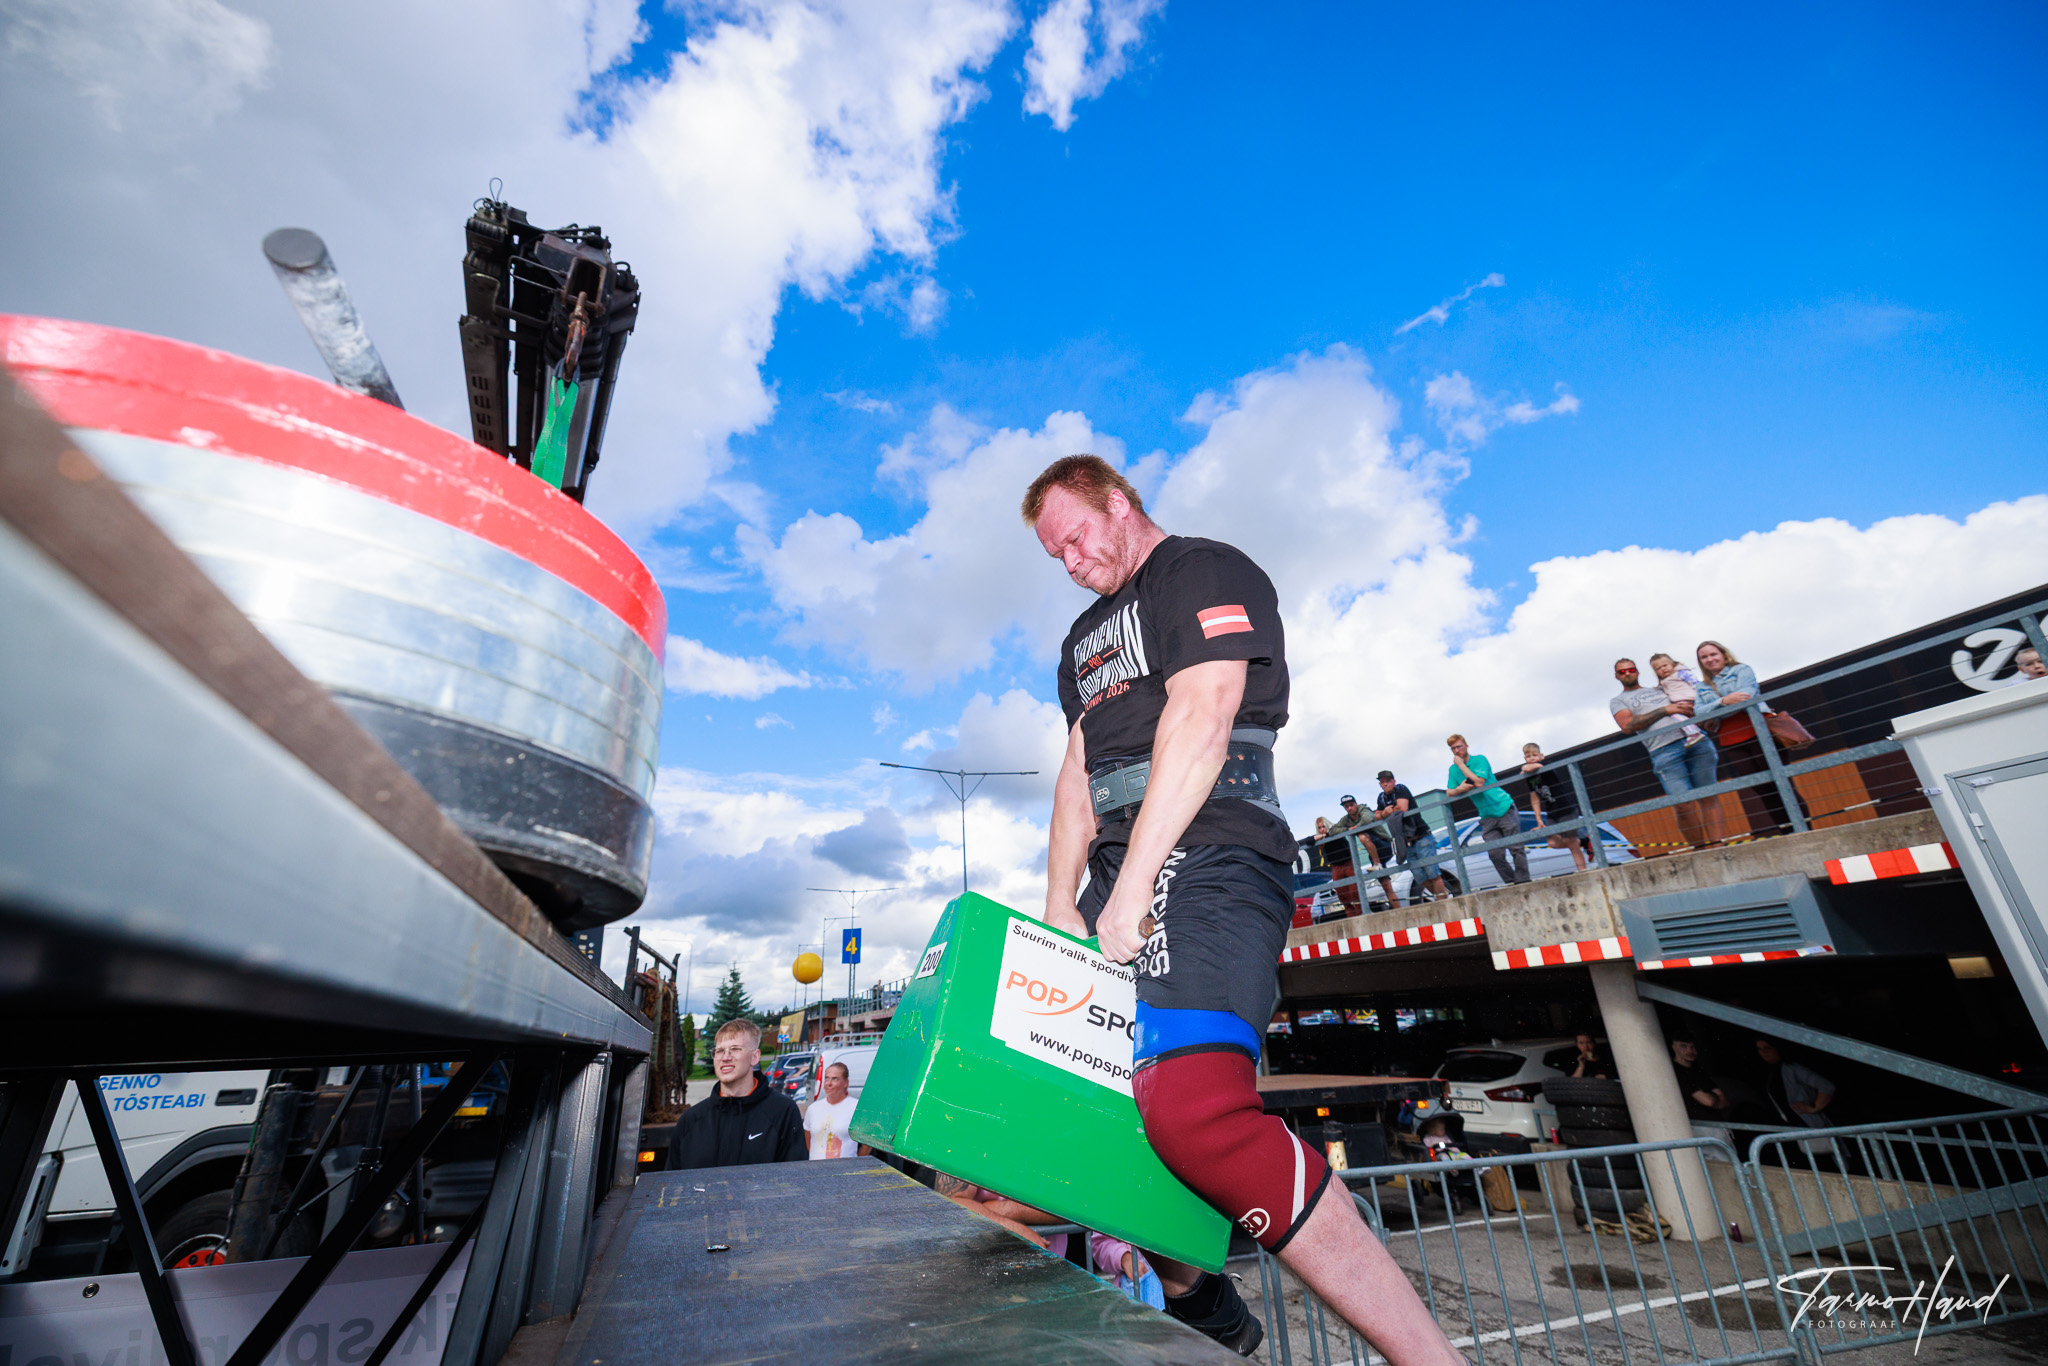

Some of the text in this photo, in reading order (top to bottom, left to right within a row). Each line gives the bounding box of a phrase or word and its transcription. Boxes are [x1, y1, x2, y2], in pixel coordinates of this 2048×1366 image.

[845, 936, 858, 955] 4
[1012, 924, 1057, 950] Suurim
[1060, 945, 1088, 964] valik
[1090, 958, 1138, 986] spordiv
[921, 949, 942, 973] 200
[1006, 970, 1068, 1007] POP
[1030, 1030, 1132, 1081] www.popspo
[99, 1074, 162, 1091] GENNO
[113, 1093, 206, 1112] TÕSTEABI
